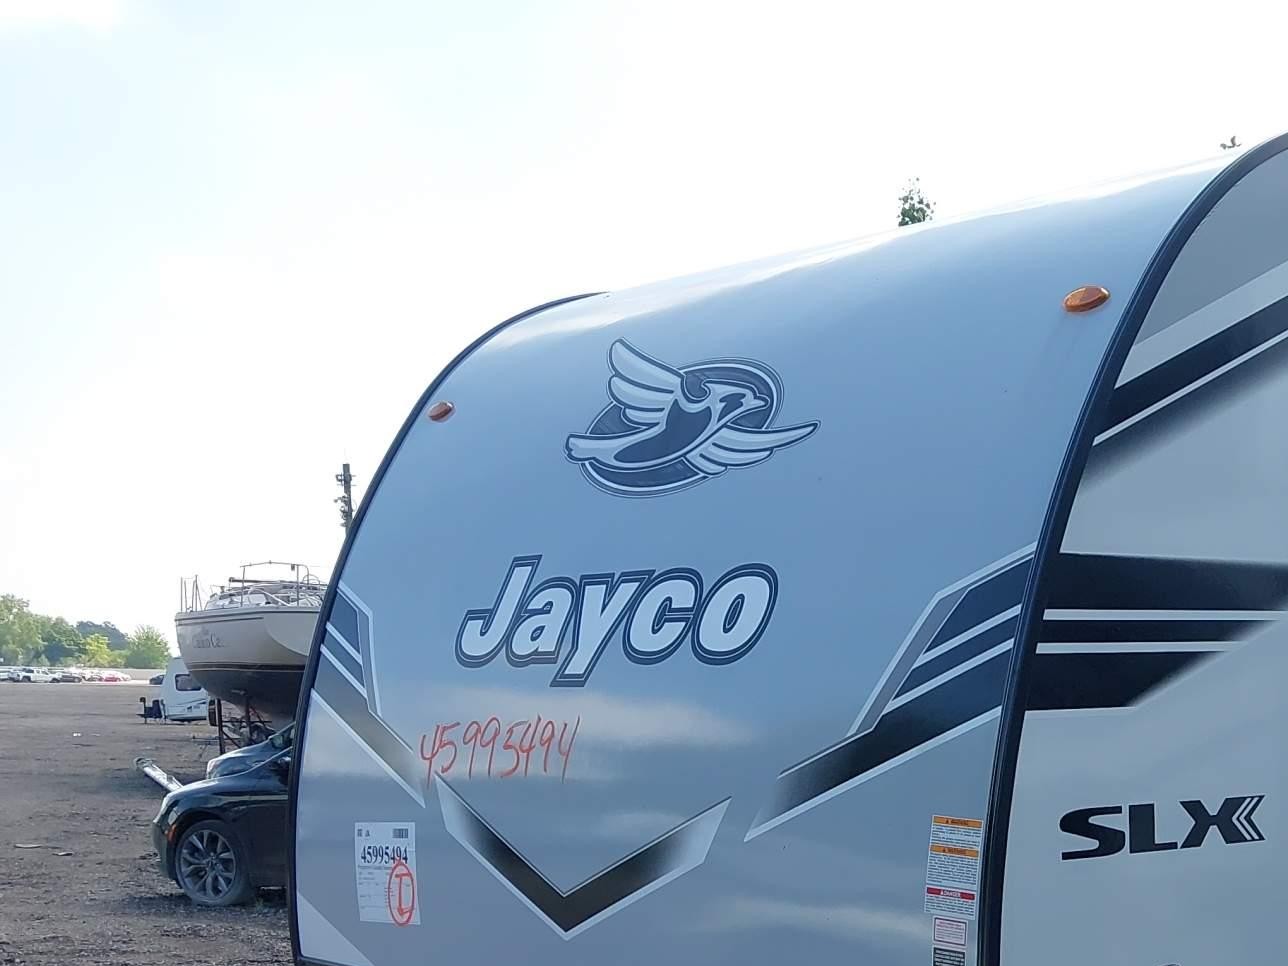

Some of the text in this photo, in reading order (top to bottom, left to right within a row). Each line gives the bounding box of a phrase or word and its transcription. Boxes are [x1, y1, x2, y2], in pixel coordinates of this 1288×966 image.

[454, 554, 779, 687] Jayco
[420, 713, 581, 790] 45995494
[360, 845, 409, 865] 45995494
[1059, 795, 1266, 861] SLX
